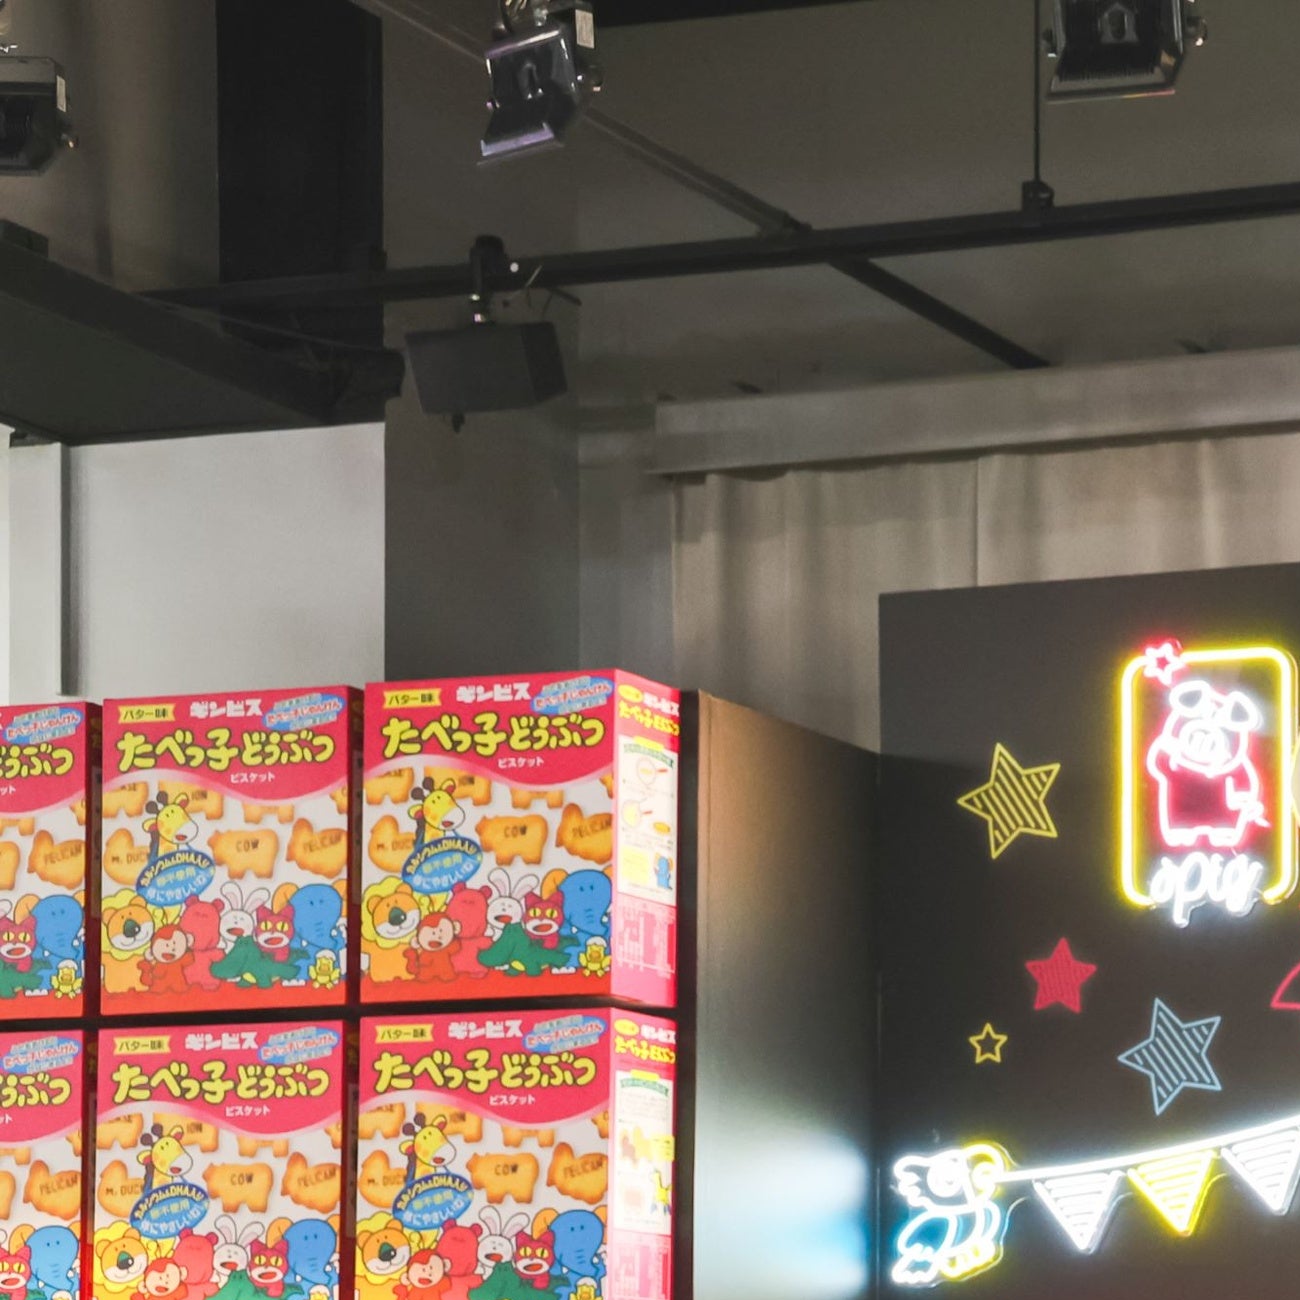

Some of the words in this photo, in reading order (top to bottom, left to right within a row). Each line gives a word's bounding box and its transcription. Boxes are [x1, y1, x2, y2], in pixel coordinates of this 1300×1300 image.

[456, 682, 531, 704] ギンビス
[190, 698, 263, 719] ギンビス
[381, 712, 605, 758] たべっ子どうぶつ
[116, 727, 335, 773] たべっ子どうぶつ
[498, 756, 544, 769] ビスケット
[230, 772, 276, 784] ビスケット
[503, 825, 528, 837] COW
[235, 839, 259, 851] COW
[448, 1019, 523, 1040] ギンビス
[185, 1031, 258, 1052] ギンビス
[373, 1048, 597, 1095] たべっ子どうぶつ
[111, 1060, 330, 1106] たべっ子どうぶつ
[489, 1094, 536, 1107] ビスケット
[225, 1105, 271, 1117] ビスケット
[494, 1163, 518, 1175] COW
[230, 1173, 253, 1185] COW
